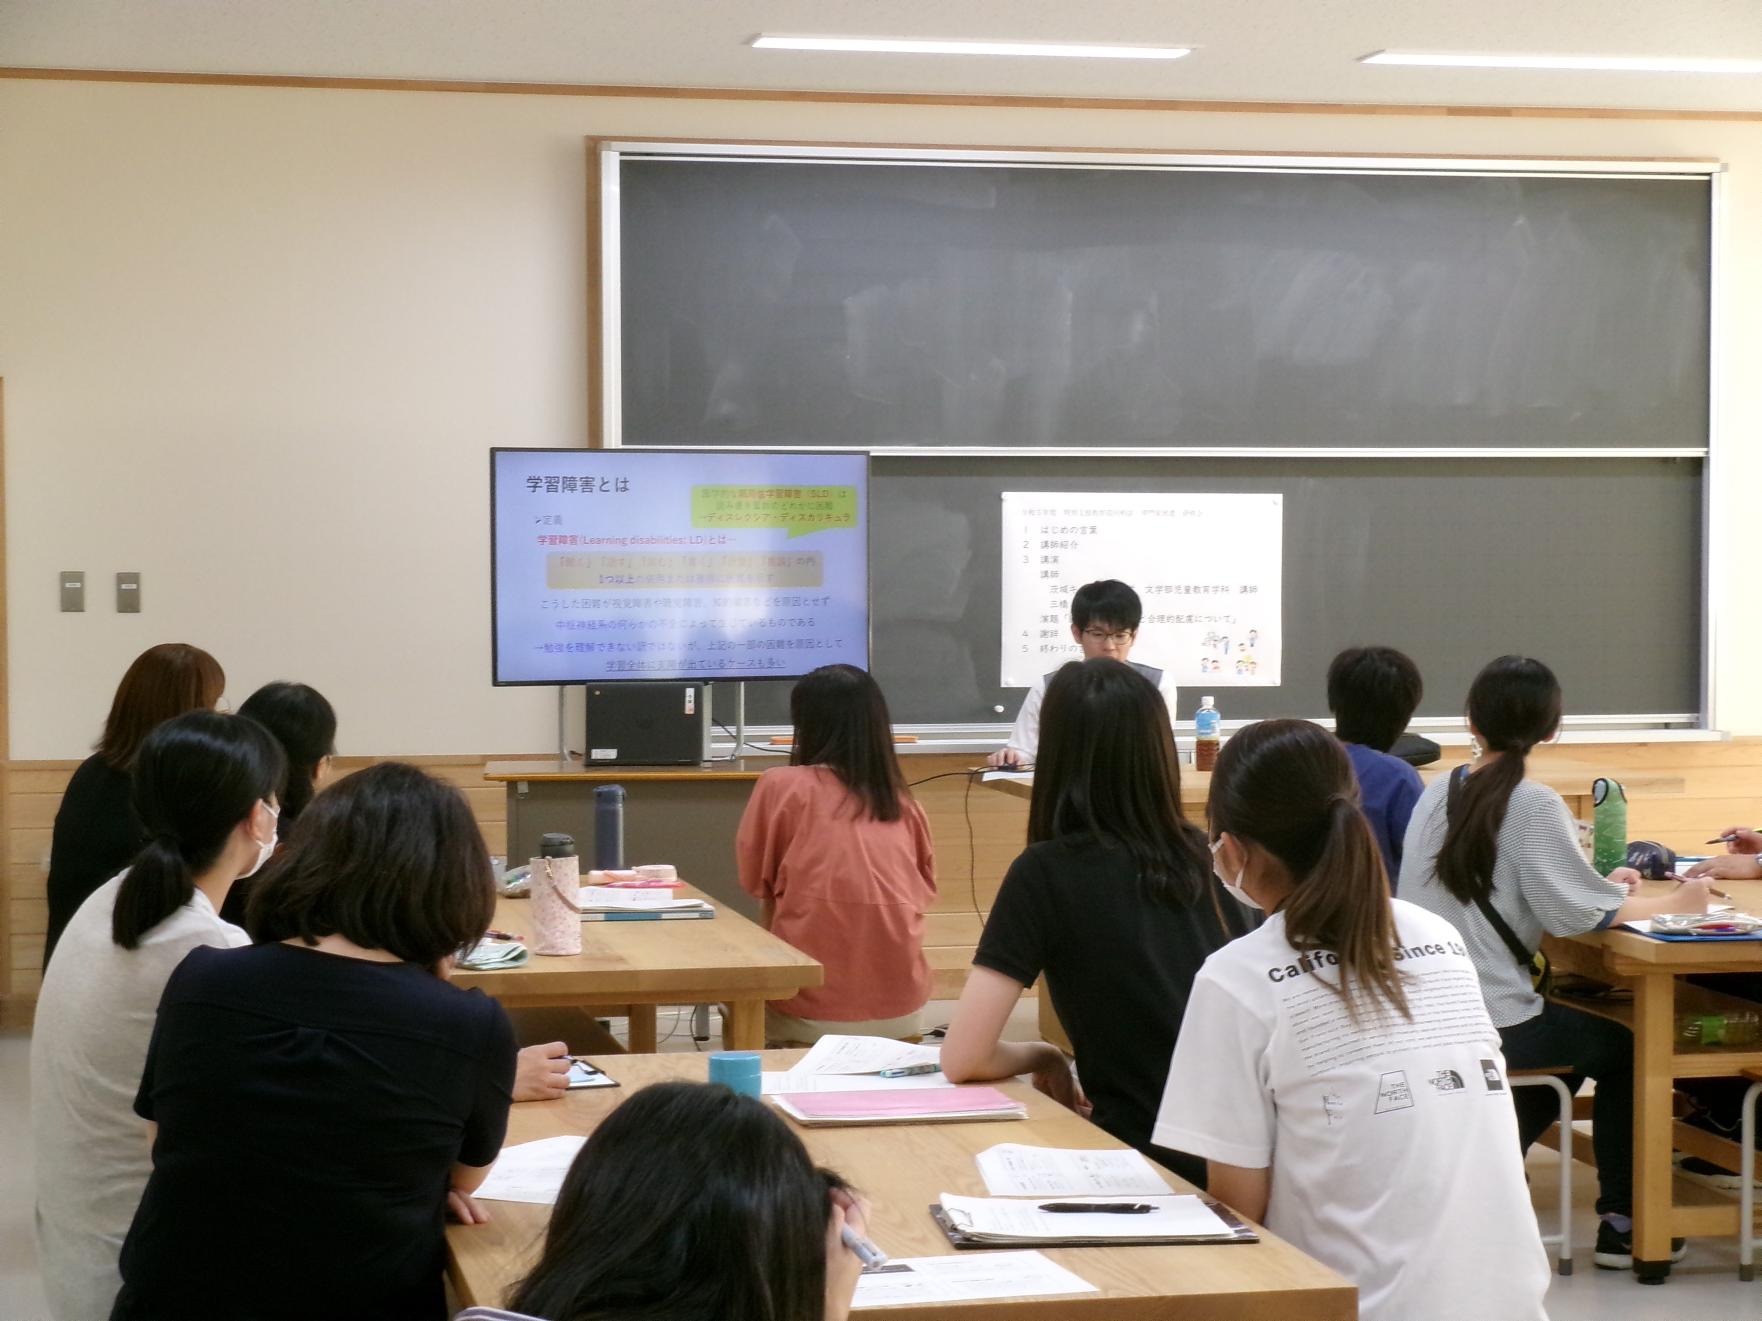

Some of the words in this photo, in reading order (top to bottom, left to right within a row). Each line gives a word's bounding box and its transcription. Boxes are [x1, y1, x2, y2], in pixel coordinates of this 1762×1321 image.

[526, 475, 630, 494] 学習障害とは
[543, 515, 563, 526] 定義
[1040, 525, 1098, 535] はじめの言葉
[1023, 540, 1029, 549] 2
[1040, 540, 1079, 550] 講師紹介
[1023, 555, 1029, 564] 3
[1040, 570, 1060, 579] 講師
[1239, 585, 1258, 595] 講師
[1022, 630, 1029, 638] 4
[1022, 644, 1029, 653] 5
